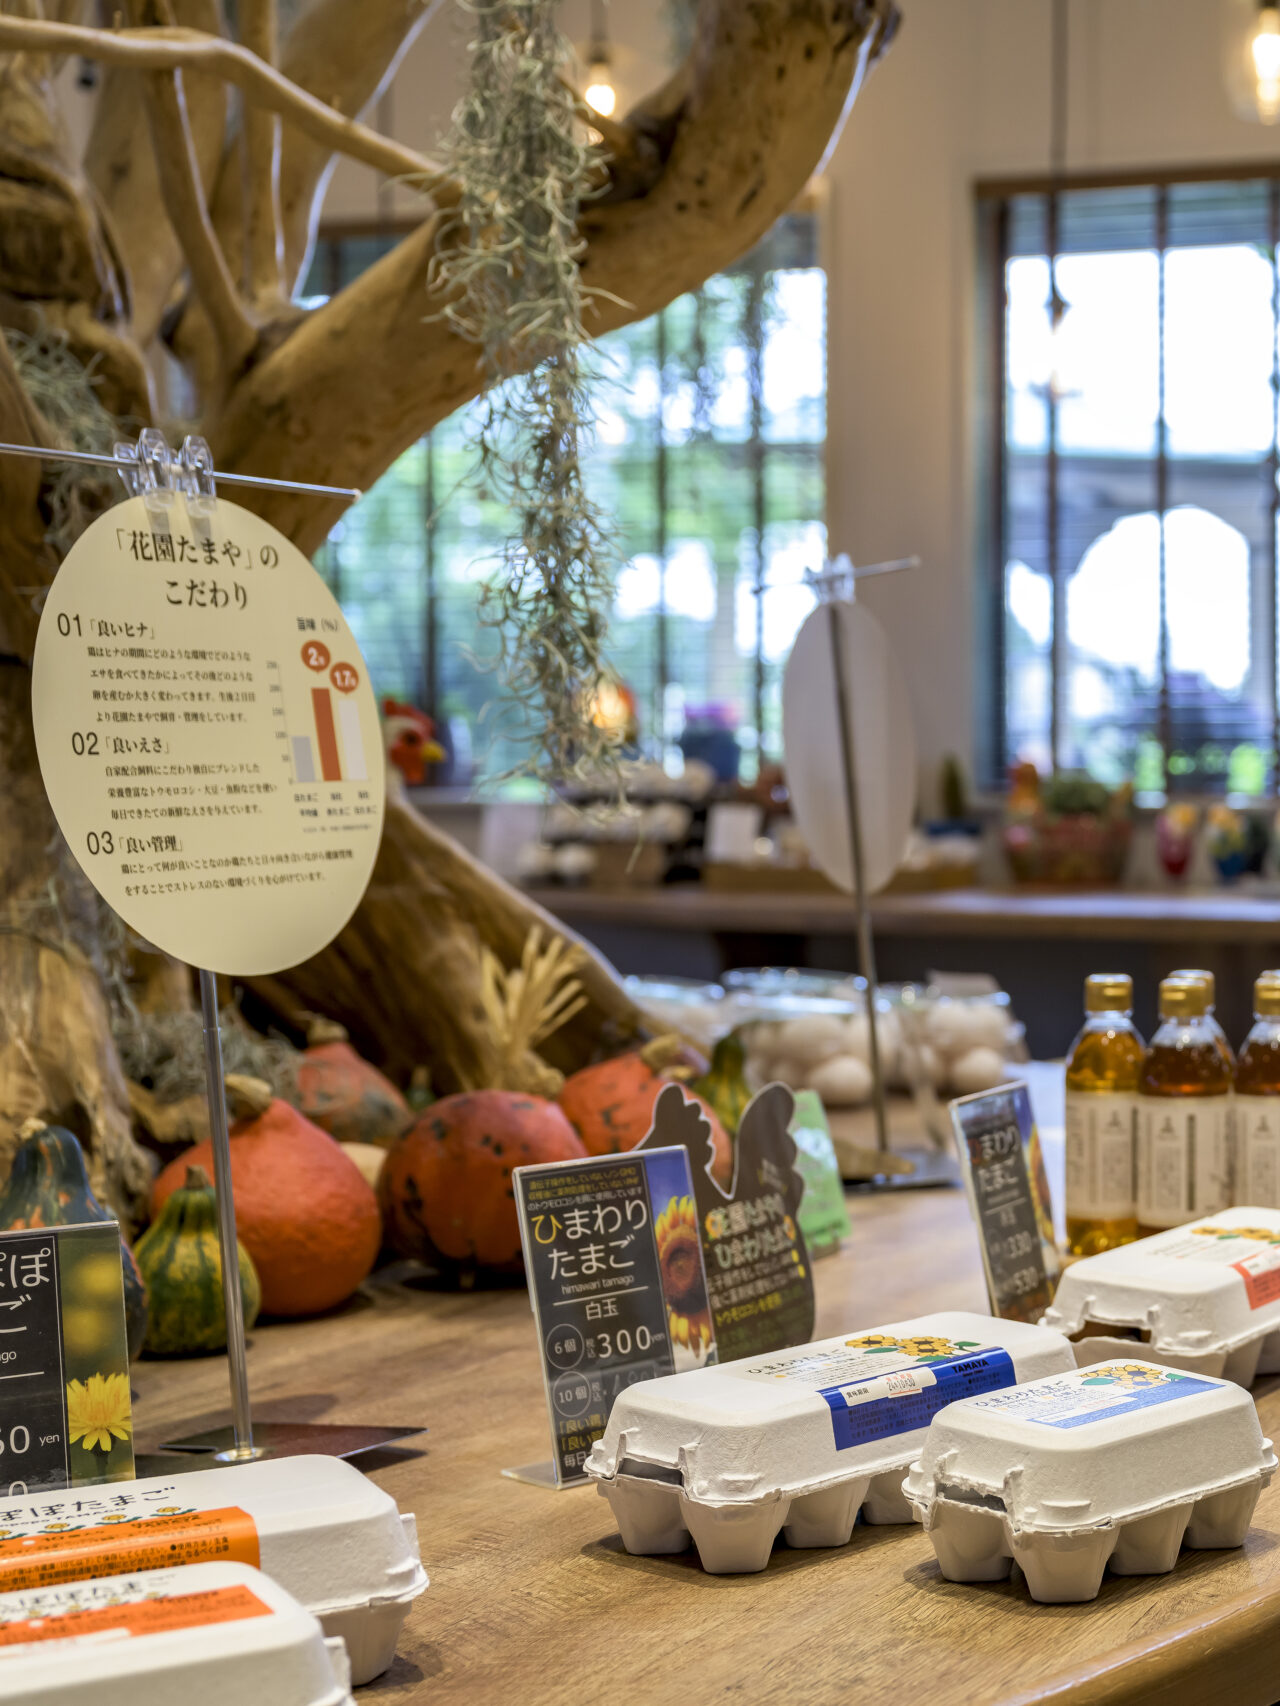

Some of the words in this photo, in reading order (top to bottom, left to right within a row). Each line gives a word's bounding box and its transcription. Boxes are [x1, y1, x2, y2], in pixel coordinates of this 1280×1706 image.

[116, 528, 279, 569] 「花園たまや」の
[165, 579, 248, 610] こだわり
[57, 613, 82, 637] 01
[89, 619, 156, 640] 「良いヒナ」
[72, 732, 100, 755] 02
[104, 736, 170, 754] 「良いえさ」
[86, 831, 115, 855] 03
[118, 835, 183, 853] 「良い管理」
[531, 1200, 648, 1244] ひまわり
[0, 1247, 51, 1288] ぽ
[548, 1234, 635, 1280] たまご
[561, 1280, 600, 1295] himawari
[602, 1275, 634, 1289] tamago
[585, 1298, 618, 1320] 白玉
[597, 1325, 651, 1359] 300
[0, 1350, 17, 1364] go
[952, 1359, 989, 1373] TAMAYA
[0, 1425, 30, 1455] 0
[39, 1434, 60, 1447] yen
